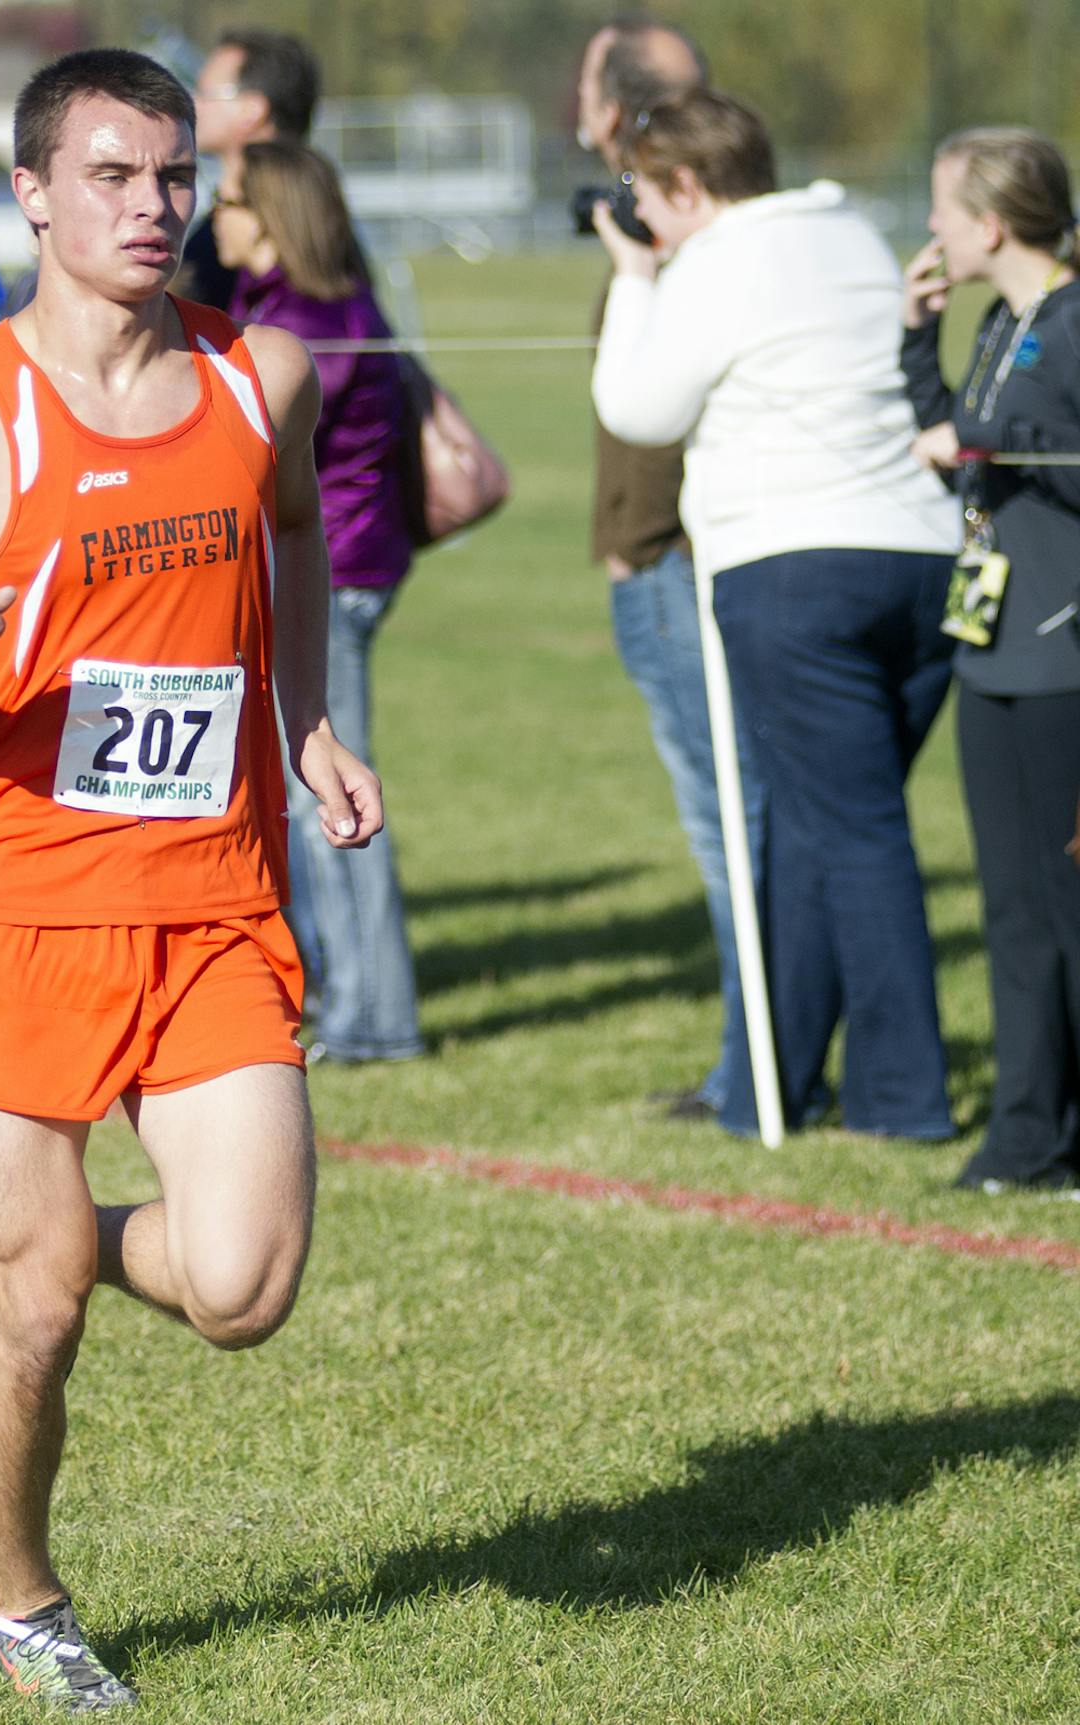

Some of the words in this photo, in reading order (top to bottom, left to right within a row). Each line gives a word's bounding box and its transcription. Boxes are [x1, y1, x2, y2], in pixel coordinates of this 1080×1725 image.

[94, 471, 128, 487] asics
[81, 507, 238, 585] FARMINGTON
[104, 544, 217, 580] TIGERS
[87, 668, 144, 690] SOUTH
[150, 673, 234, 691] SUBURBAN
[133, 691, 158, 700] CROSS
[160, 692, 193, 701] COUNTRY
[92, 706, 212, 776] 207
[75, 775, 212, 800] CHAMPIONSHIPS
